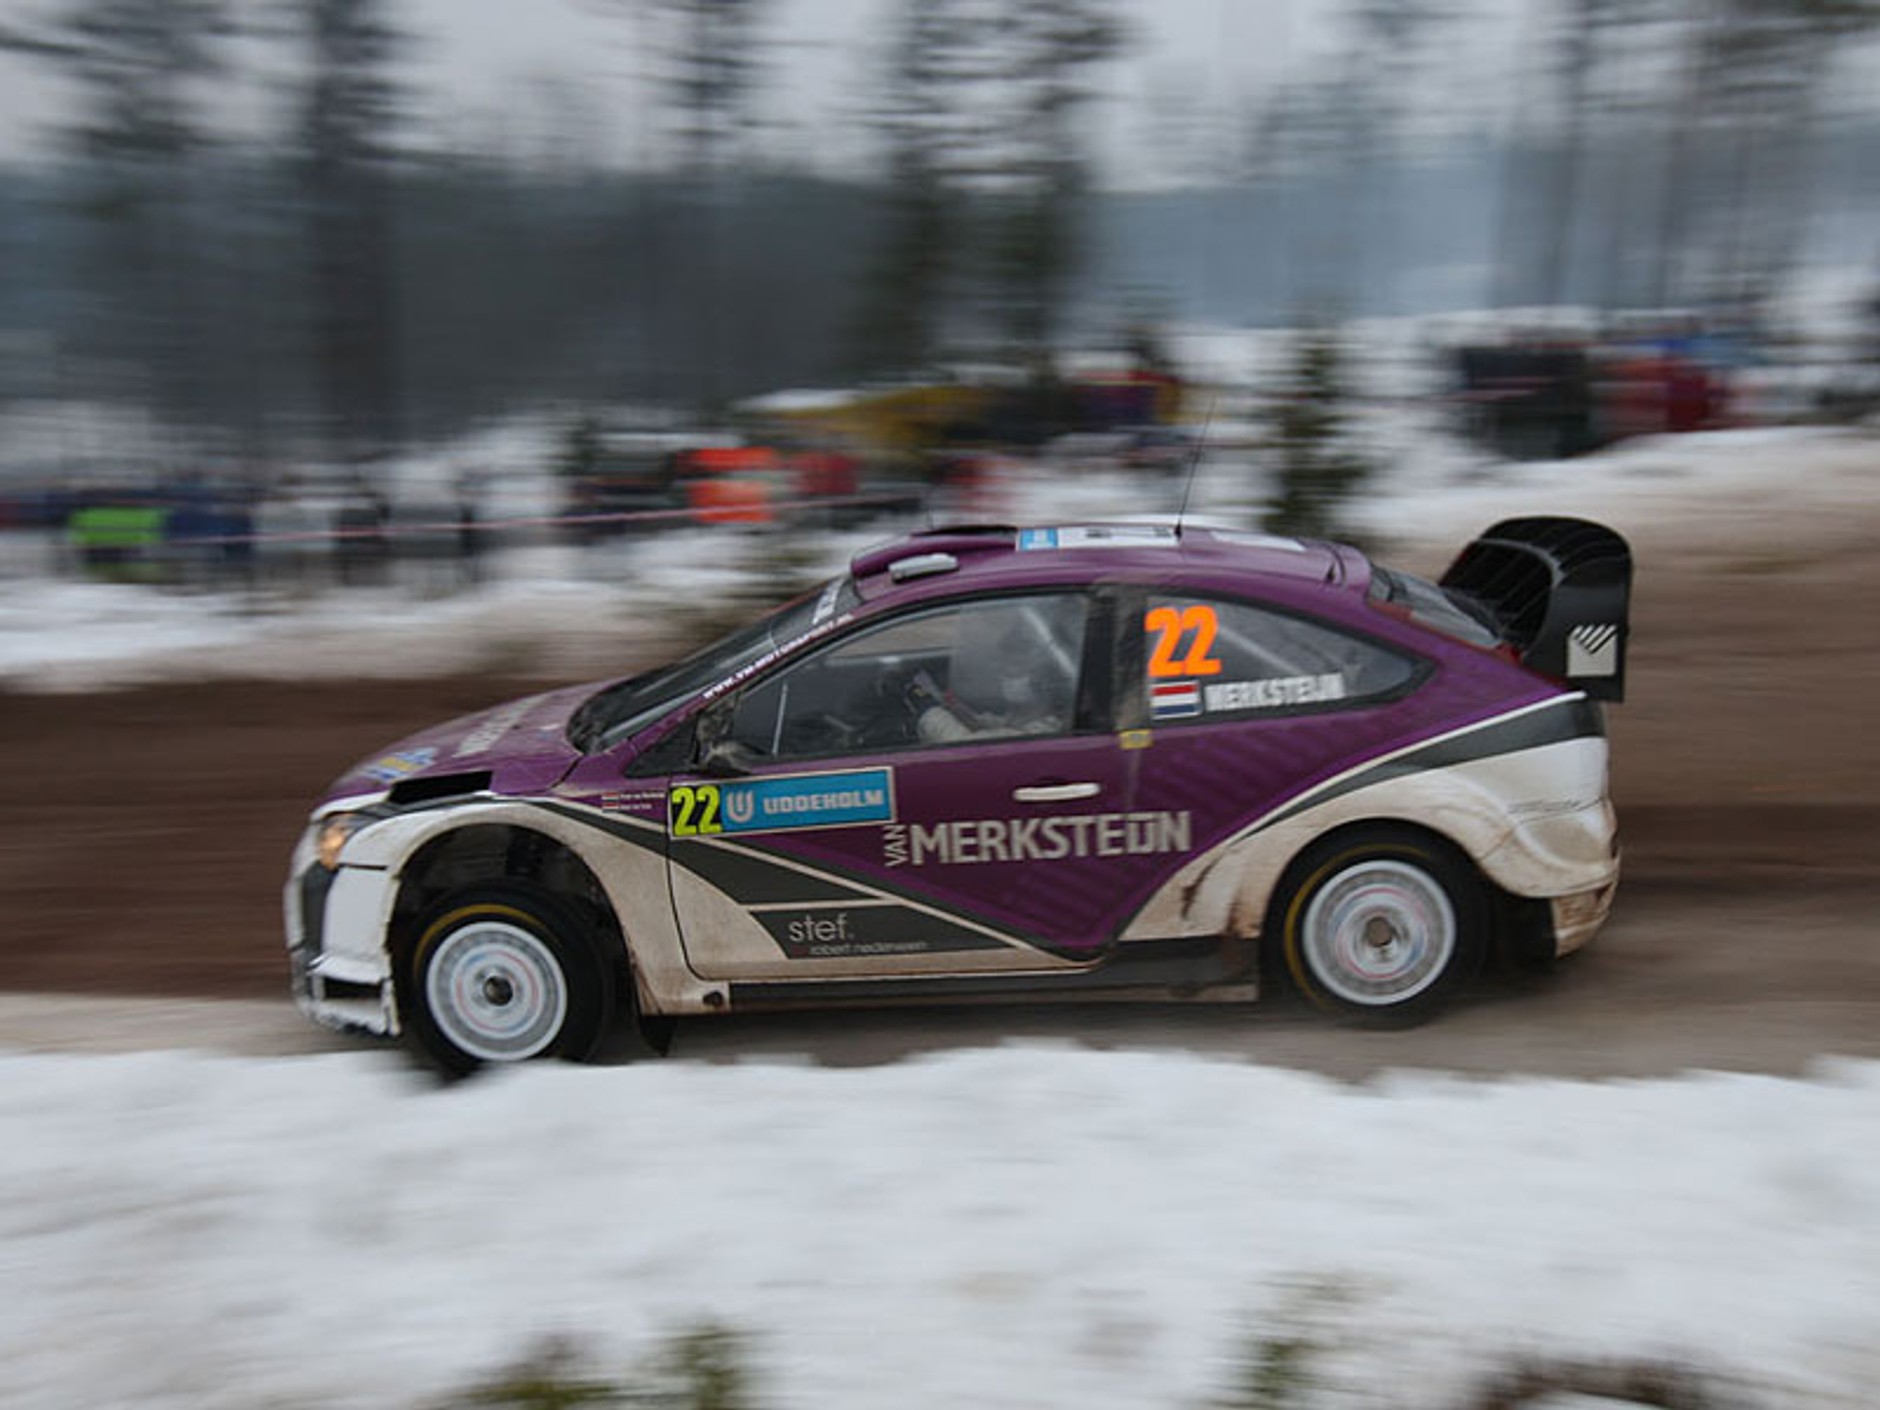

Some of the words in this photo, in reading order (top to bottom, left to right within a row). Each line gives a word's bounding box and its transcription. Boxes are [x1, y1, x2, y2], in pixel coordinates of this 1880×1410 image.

[1144, 604, 1222, 677] 22
[671, 784, 722, 836] 22
[763, 789, 885, 814] UDDEHOLM
[884, 824, 908, 867] VAN
